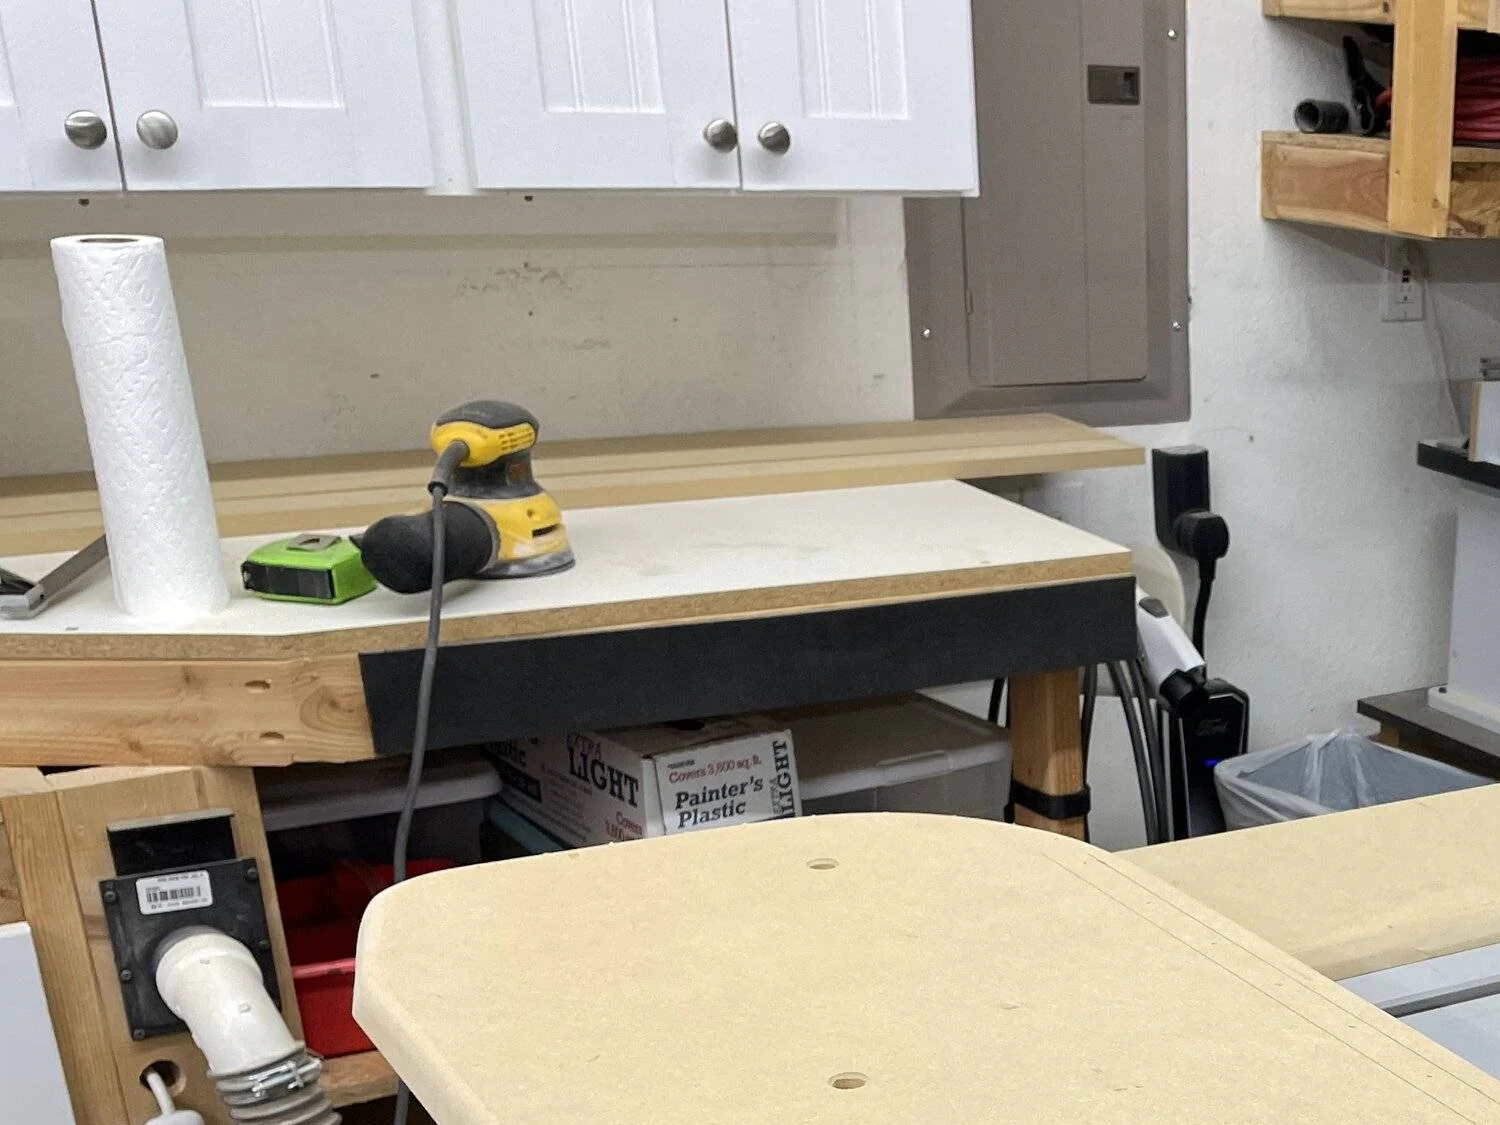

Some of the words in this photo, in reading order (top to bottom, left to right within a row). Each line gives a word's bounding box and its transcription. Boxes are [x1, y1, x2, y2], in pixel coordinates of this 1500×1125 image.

[568, 747, 639, 808] LIGHT
[668, 767, 706, 783] Covers
[675, 775, 764, 811] Painter's
[772, 740, 796, 817] LIGHT
[677, 799, 747, 829] Plastic
